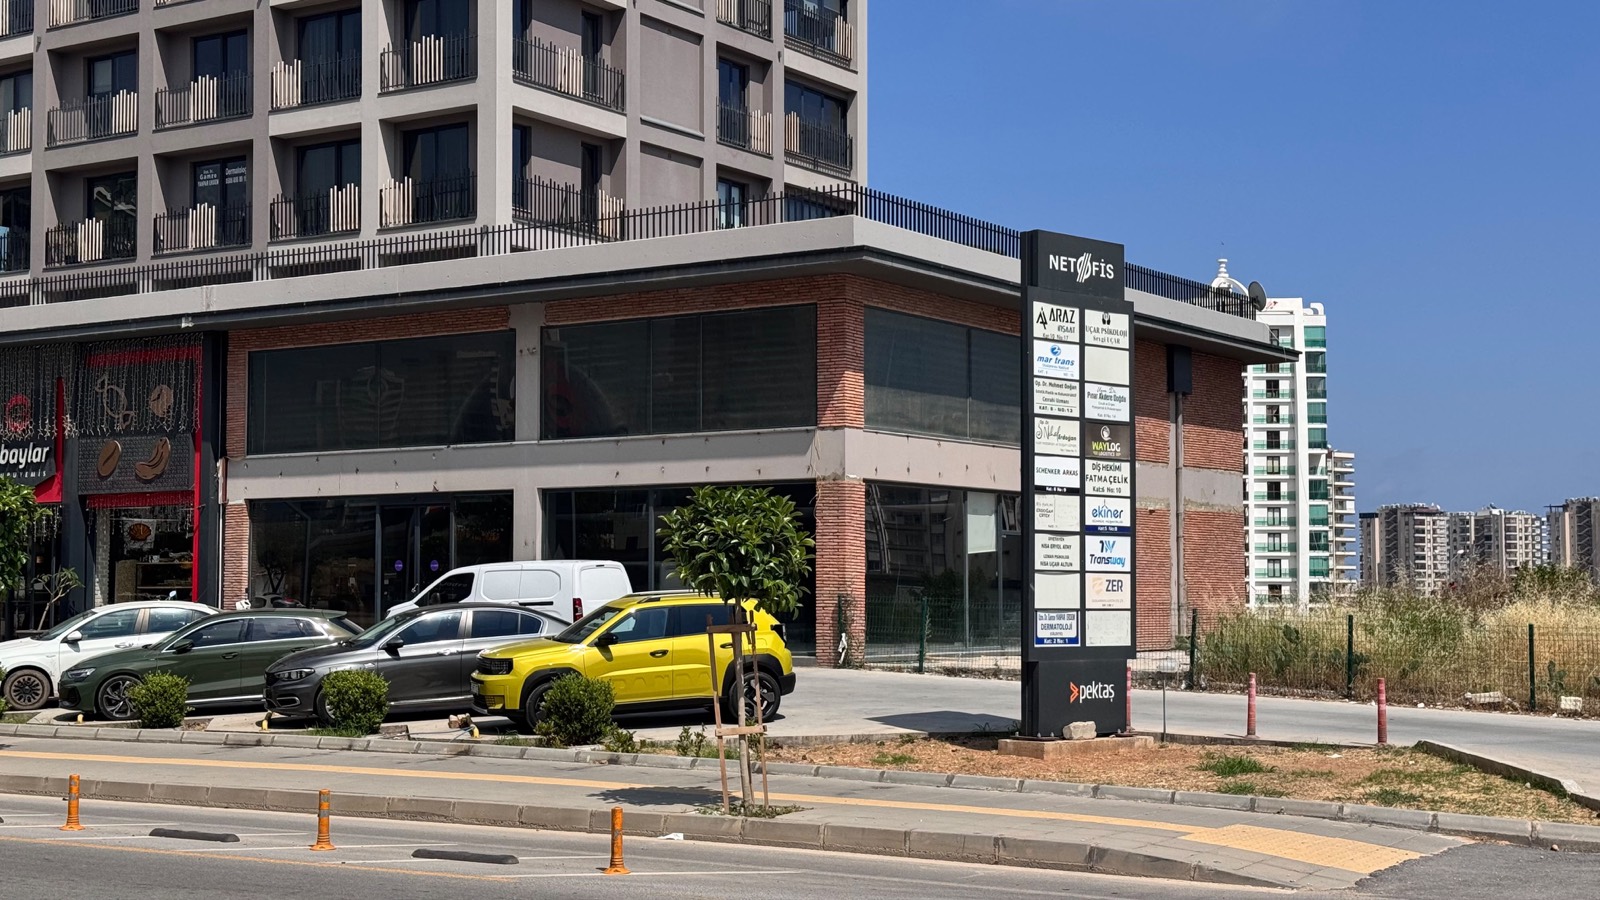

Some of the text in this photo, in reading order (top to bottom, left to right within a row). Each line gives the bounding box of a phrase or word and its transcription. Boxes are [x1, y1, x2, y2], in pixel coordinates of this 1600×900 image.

[1049, 307, 1075, 324] ARAZ
[1101, 327, 1127, 338] PSİKOLOJİ
[1037, 356, 1052, 364] mar
[1055, 357, 1075, 367] trans
[1092, 442, 1121, 452] WAYLOG
[1036, 467, 1079, 477] SCHENKER ARKAS
[1092, 462, 1121, 472] DİŞ HEKİMİ
[1086, 475, 1129, 485] FATMA ÇELİK
[1092, 505, 1124, 519] ekiner
[1090, 554, 1126, 568] Transway
[1106, 579, 1124, 593] ZER
[1041, 622, 1073, 631] DERMATOLOJİ
[1080, 681, 1115, 703] pektaş
